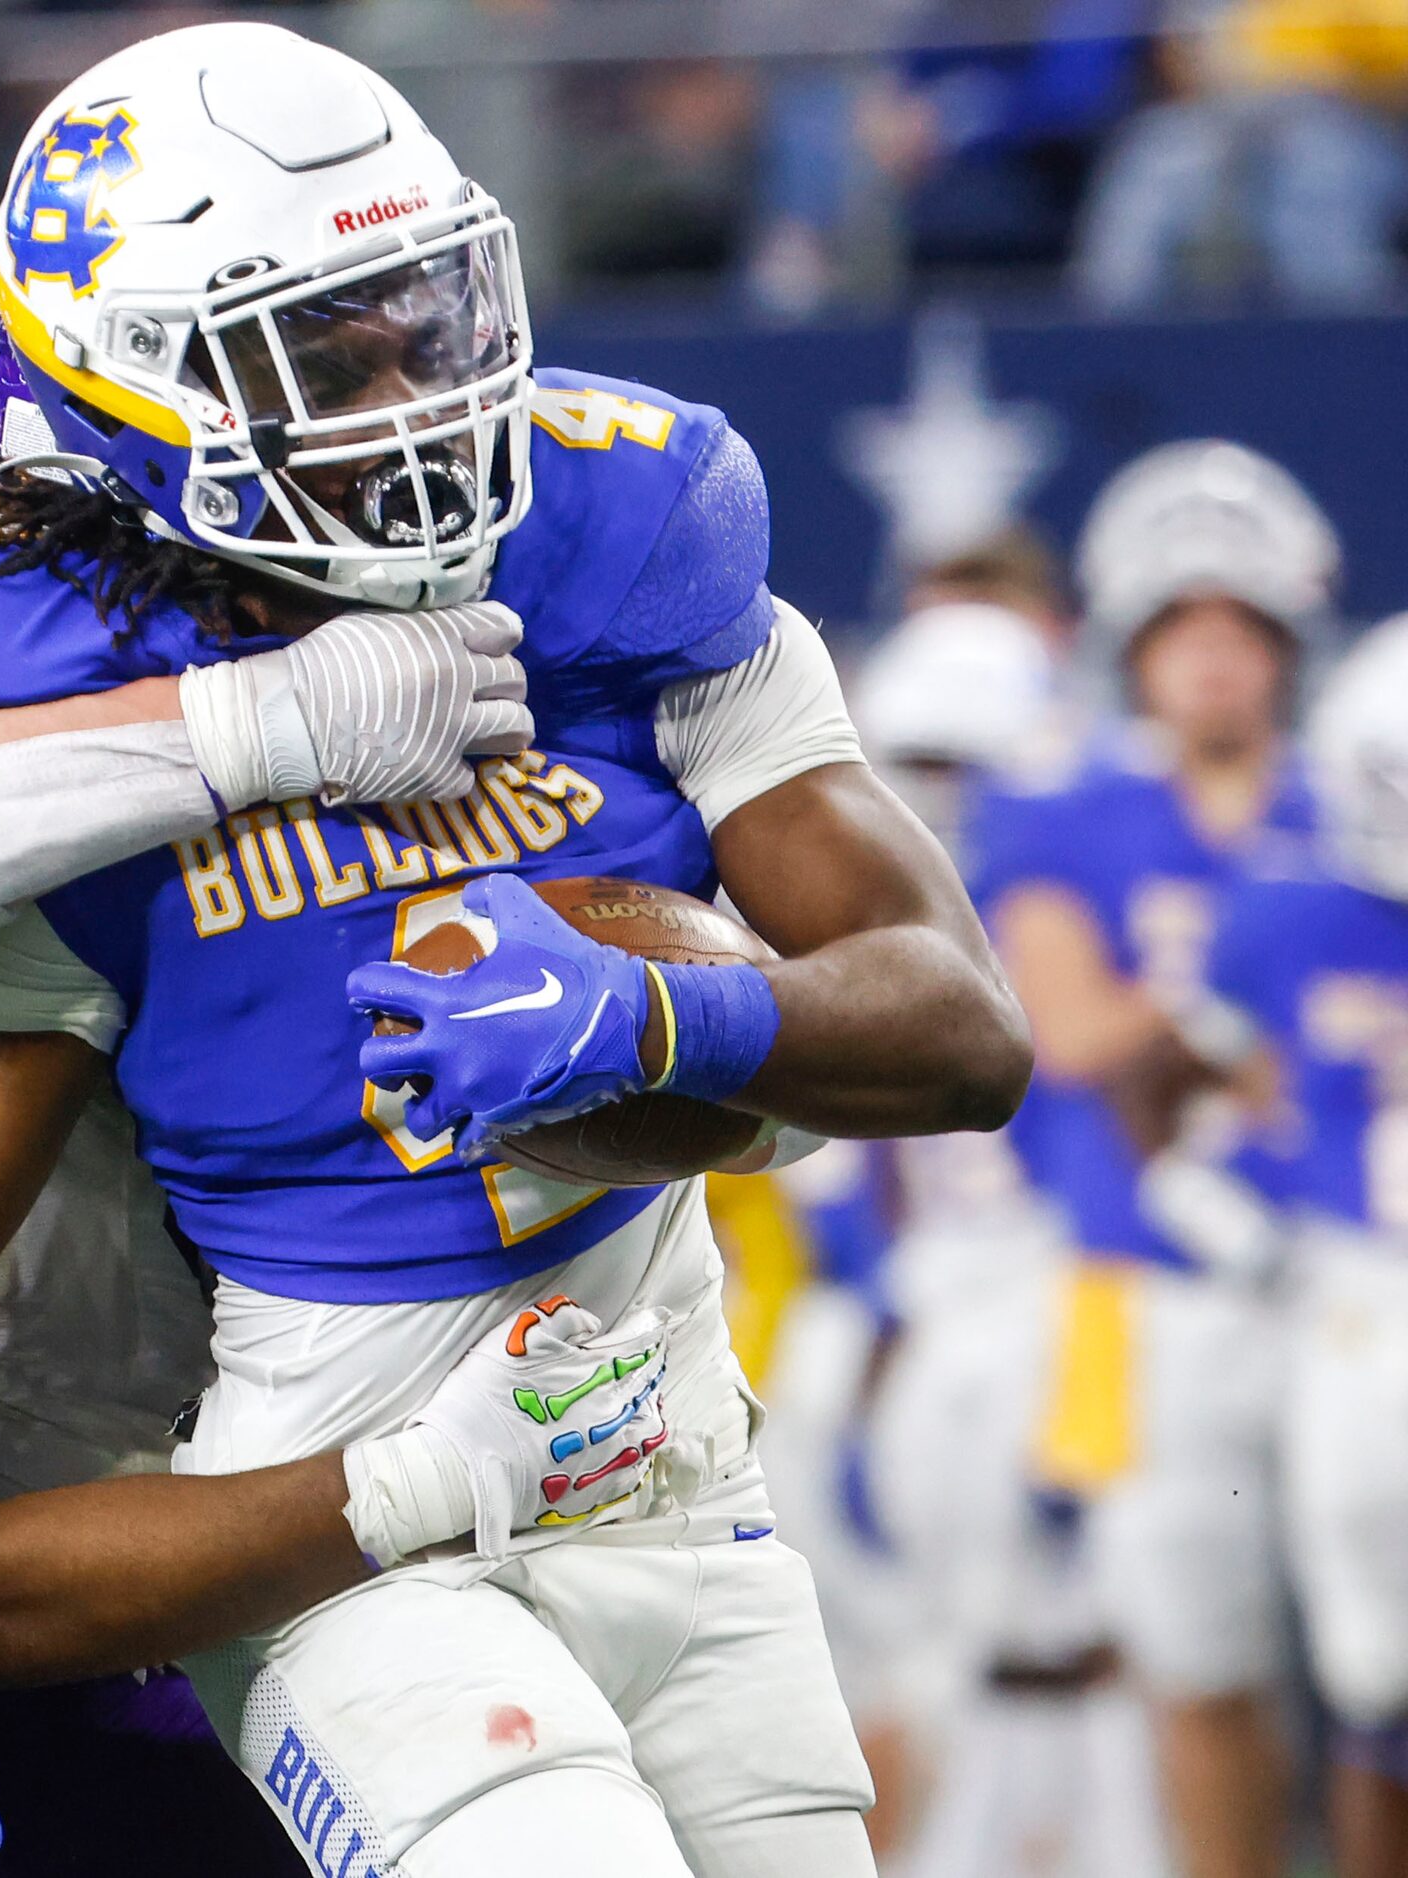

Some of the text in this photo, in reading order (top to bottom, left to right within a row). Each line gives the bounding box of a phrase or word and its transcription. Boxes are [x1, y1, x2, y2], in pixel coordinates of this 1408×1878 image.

[333, 184, 429, 235] Riddell
[530, 387, 677, 451] 4
[264, 1726, 381, 1878] BULL
